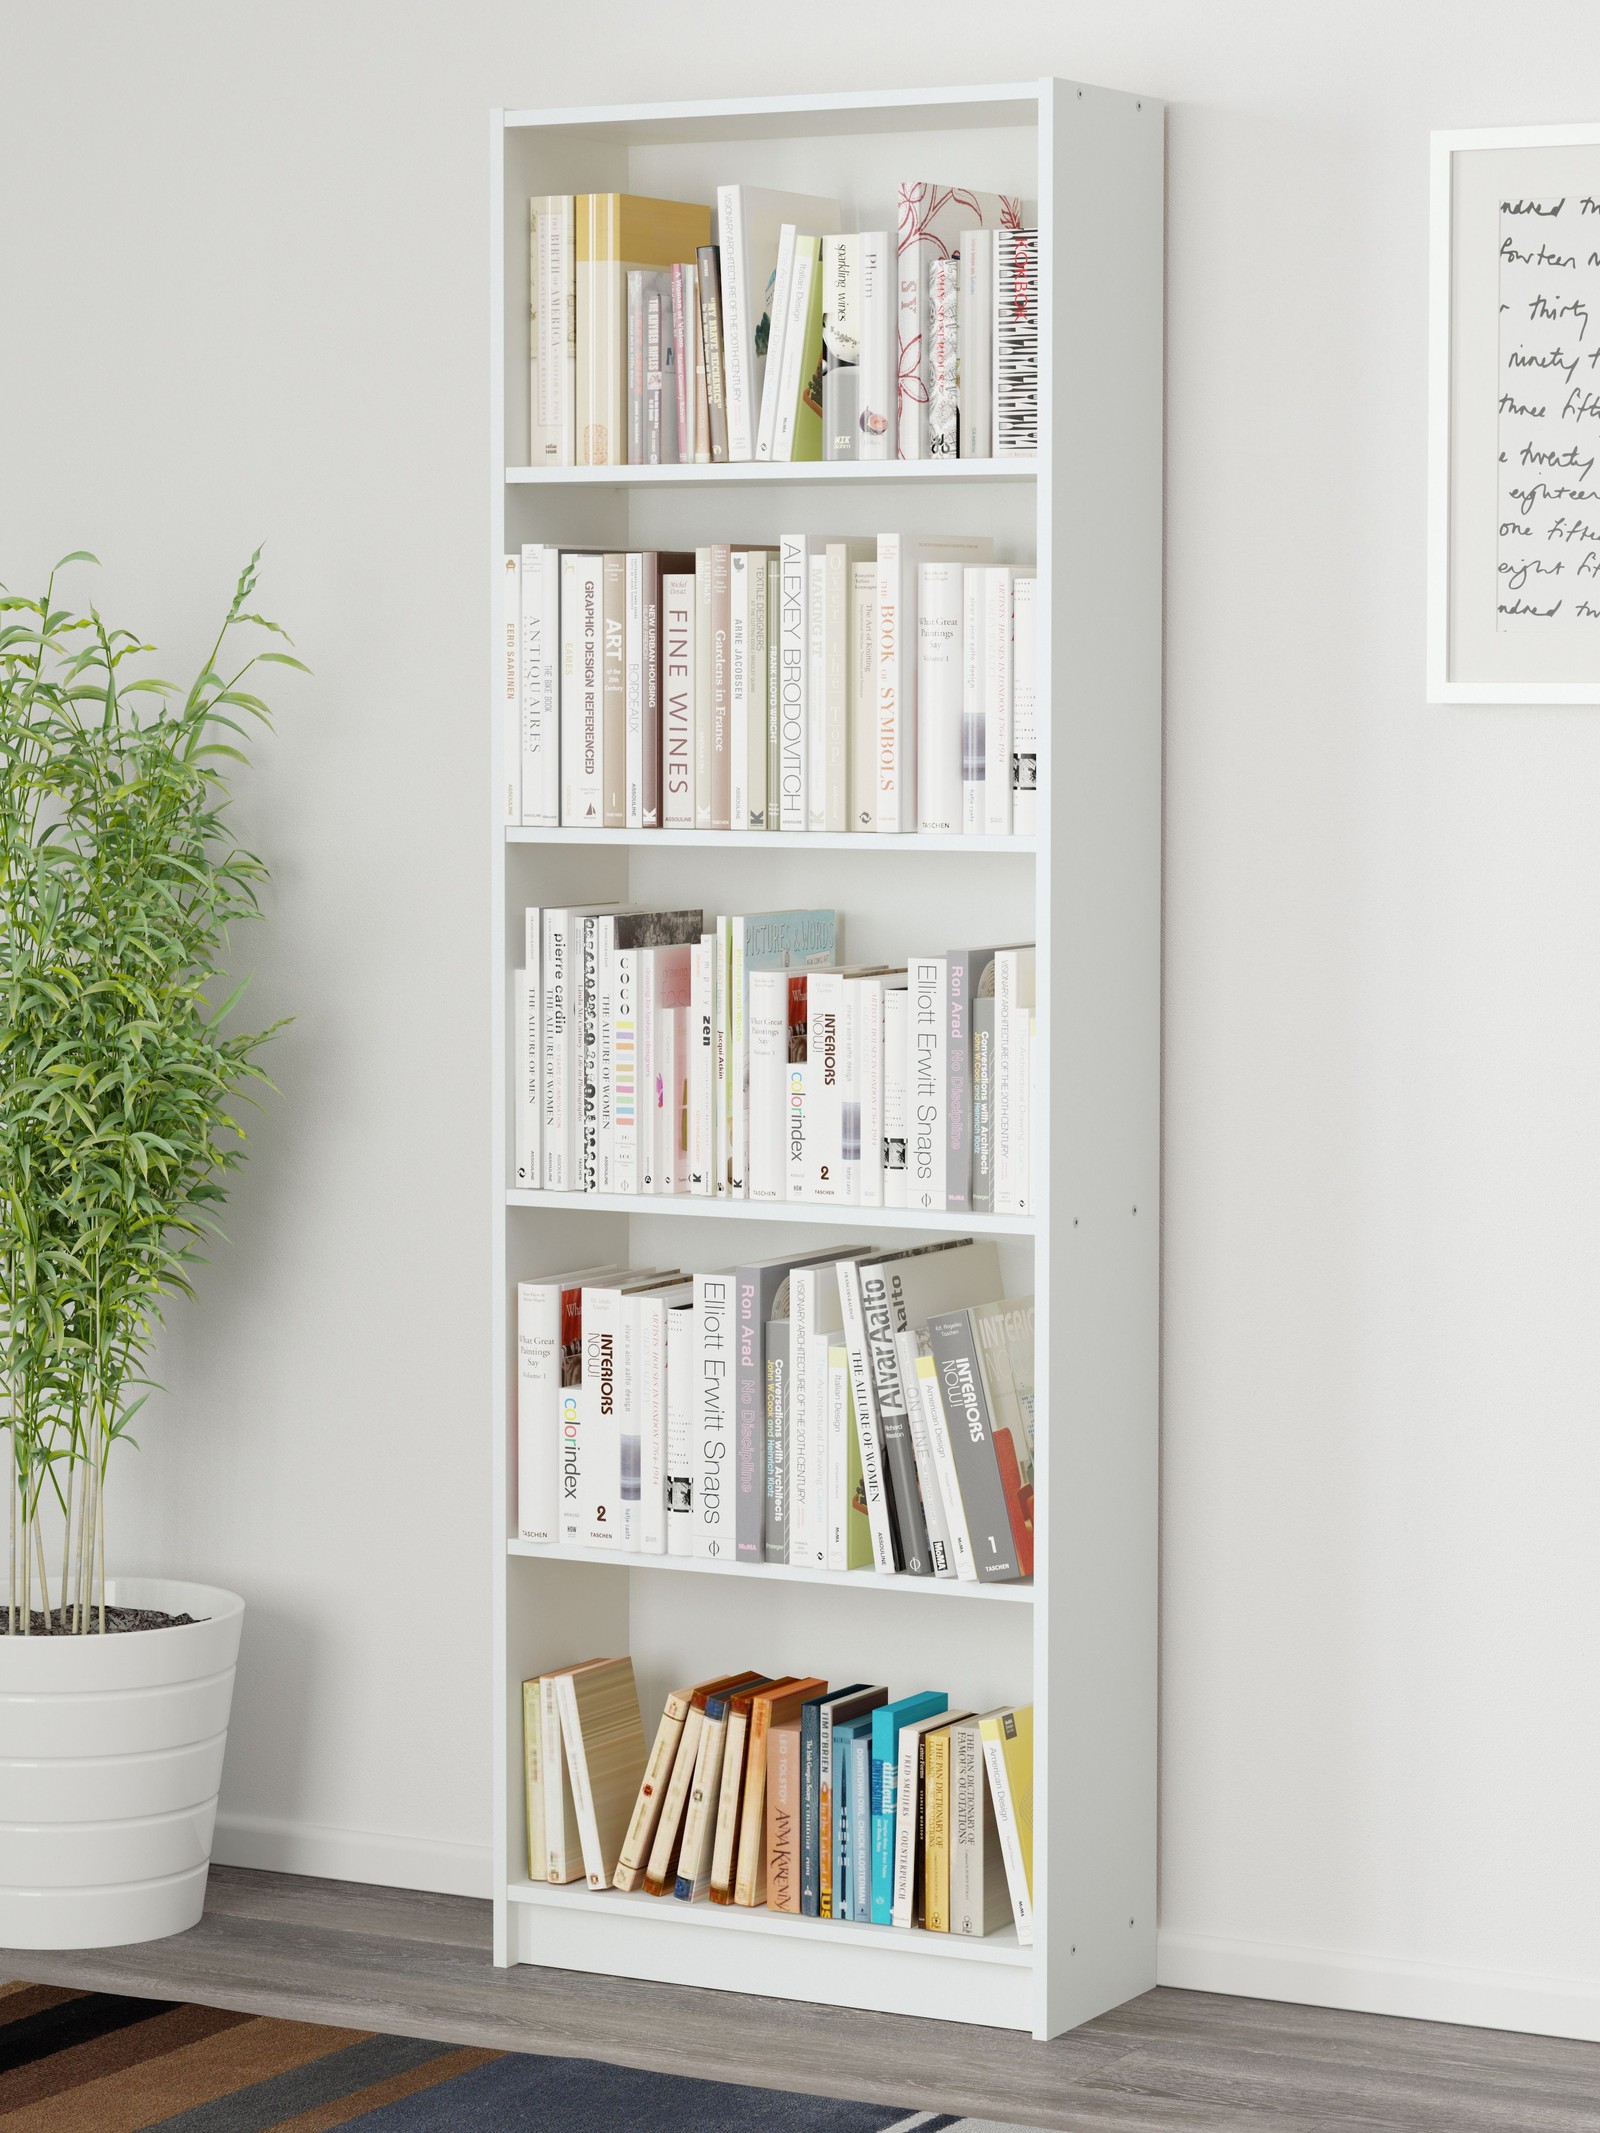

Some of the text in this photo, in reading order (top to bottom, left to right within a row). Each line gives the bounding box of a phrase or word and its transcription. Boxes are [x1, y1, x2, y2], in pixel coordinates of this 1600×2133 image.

[724, 194, 742, 402] VISIONARY ARCHITECTURE OF THE 20TH CENTURY
[773, 268, 790, 333] Architectural
[793, 263, 808, 322] Italian Design
[835, 244, 849, 322] sparkling wines
[865, 254, 877, 298] Plum
[1013, 237, 1028, 322] KOKBOK
[648, 300, 659, 371] THE KHYBER RIFLES
[708, 320, 718, 350] BRAVE
[936, 269, 945, 388] WHY SO SERIOUS?
[1528, 294, 1588, 341] thirty
[766, 334, 781, 375] Drawing
[1508, 344, 1580, 384] ninety
[1499, 392, 1546, 418] three
[1519, 440, 1595, 481] twenty
[1500, 522, 1533, 536] one
[756, 566, 764, 652] TEXTILE DESIGNERS
[1498, 558, 1565, 590] eight
[507, 623, 515, 700] EERO SAARINEN
[565, 642, 573, 676] EAMES
[606, 618, 622, 661] ART
[734, 619, 743, 700] ARNE JACOBSEN
[864, 603, 873, 673] The Art of Knitting
[527, 616, 541, 753] ANTIQUAIRES
[544, 665, 553, 713] THE BIKE BOOK
[584, 581, 595, 775] GRAPHIC DESIGN REFERENCED
[628, 663, 639, 733] BORDEAUX
[669, 610, 688, 794] FINE WINES
[716, 629, 726, 752] Gardens in France
[784, 542, 801, 811] ALEXEY BRODOVITCH
[554, 933, 566, 1034] pierre cardin
[602, 995, 610, 1130] THE ALLURE OF WOMEN
[703, 1015, 712, 1046] zen
[812, 1012, 824, 1053] NOW!
[824, 1013, 836, 1086] INTERIORS
[948, 965, 964, 1150] Ron Arad No Discipline
[528, 1060, 535, 1076] OF
[911, 965, 937, 1180] Elliott Erwitt Snaps
[980, 1031, 988, 1175] Conversations with Architects
[790, 1072, 806, 1162] colorindex
[820, 1165, 834, 1181] 2
[588, 1332, 600, 1378] NOW!
[600, 1333, 613, 1415] INTERIORS
[864, 1279, 903, 1409] Alvar Aalto
[699, 1282, 726, 1525] Elliott Erwitt Snaps
[738, 1284, 755, 1493] Ron Arad No Discipline
[833, 1374, 842, 1433] Italian Design
[942, 1359, 959, 1408] NOW!
[956, 1357, 984, 1443] INTERIORS
[564, 1398, 581, 1499] colorindex
[775, 1358, 783, 1522] Conversations with Architects
[851, 1350, 881, 1503] THE ALLURE OF WOMEN
[926, 1384, 947, 1458] American Design
[597, 1505, 607, 1522] 2
[987, 1535, 998, 1554] 1
[933, 1541, 947, 1571] MoMA
[779, 1733, 787, 1805] LEO TOLSTOY
[821, 1712, 829, 1773] TIM O'BRIEN
[935, 1742, 943, 1761] THE
[935, 1763, 943, 1779] PAN
[958, 1731, 967, 1775] FAMOUS
[872, 1758, 884, 1816] CONVERSATIONS
[882, 1761, 894, 1815] difficult
[935, 1781, 943, 1834] DICTIONARY
[958, 1777, 967, 1845] QUOTATIONS
[966, 1732, 975, 1846] THE PAN DICTIONARY OF
[988, 1747, 1009, 1822] American Design
[857, 1748, 865, 1905] DOWNTOWN OWL CHUCK KLOSTERMAN
[898, 1755, 912, 1900] FRED SMEIJERS COUNTERPUNCH
[935, 1836, 943, 1849] OF
